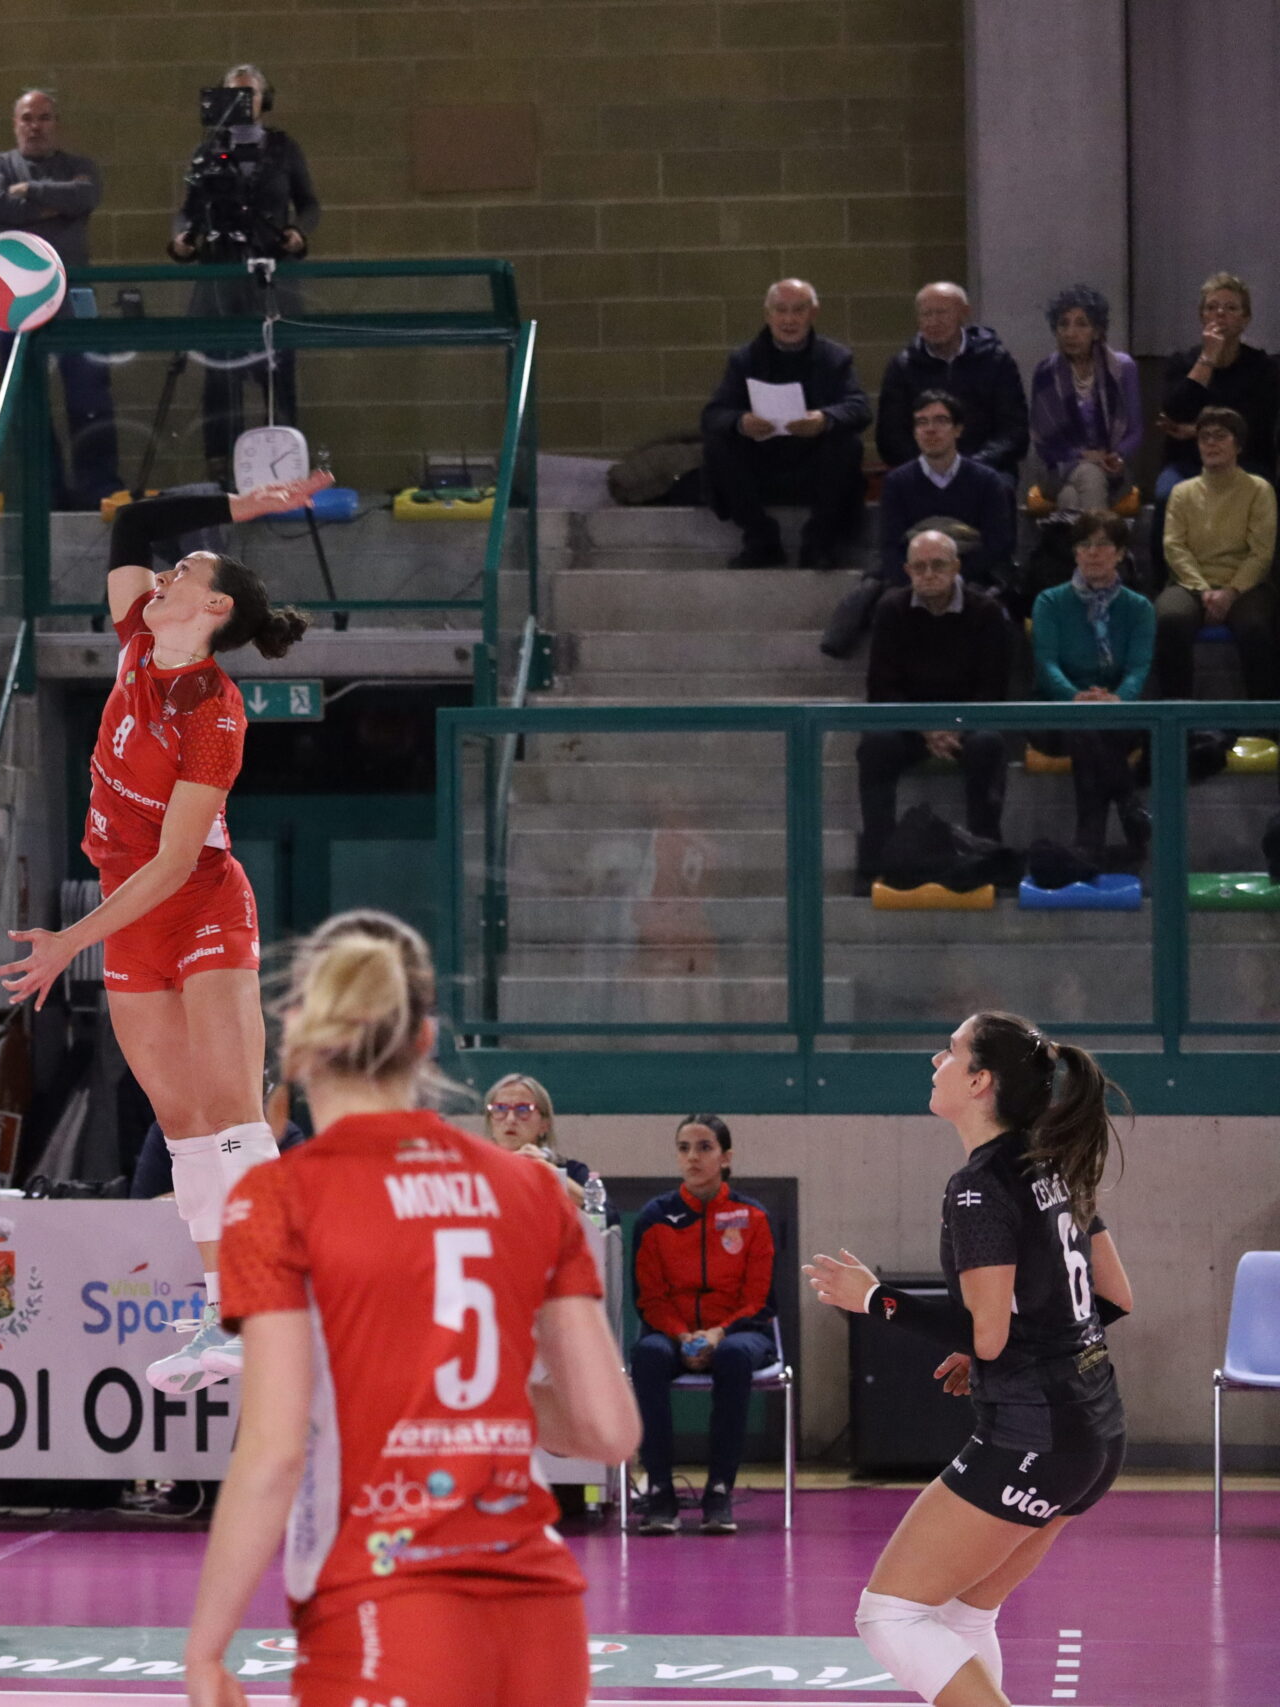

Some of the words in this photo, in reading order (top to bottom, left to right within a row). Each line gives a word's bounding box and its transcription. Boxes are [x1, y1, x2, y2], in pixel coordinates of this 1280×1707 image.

[384, 1172, 501, 1221] MONZA
[81, 1280, 205, 1345] Sport
[433, 1228, 499, 1410] 5
[83, 1367, 238, 1454] OFF
